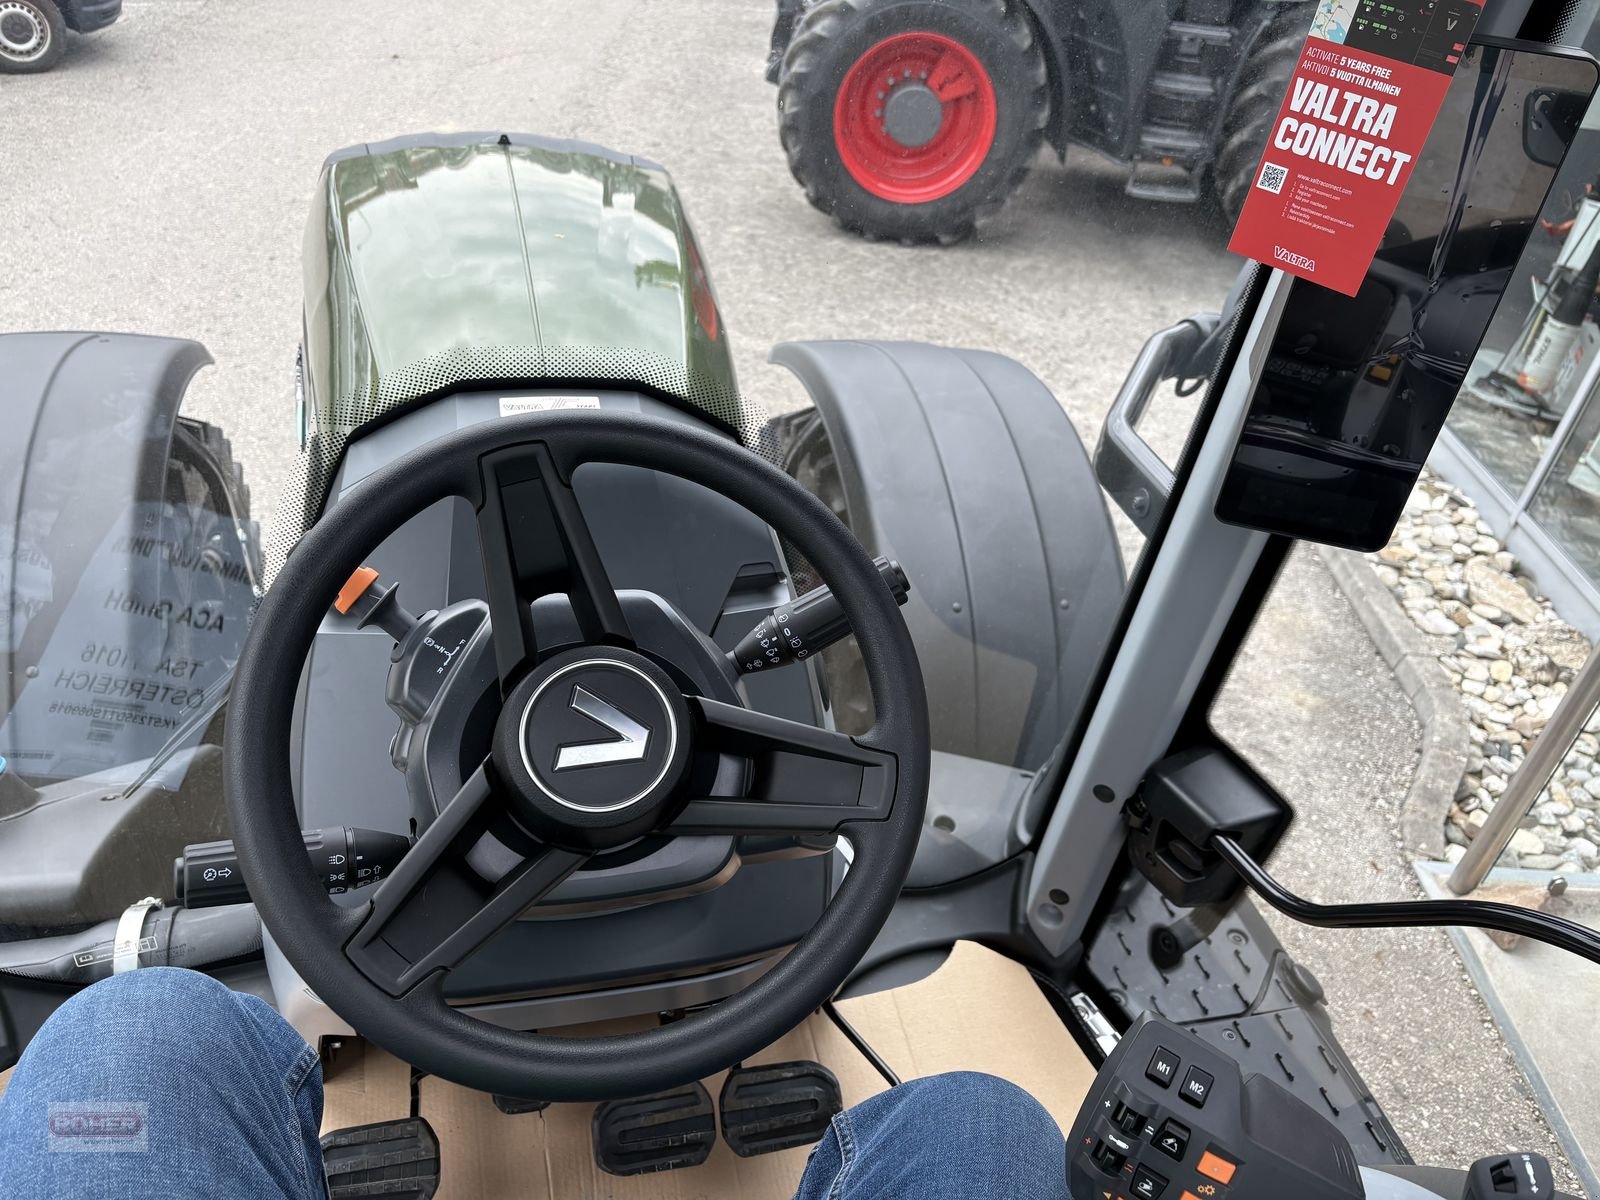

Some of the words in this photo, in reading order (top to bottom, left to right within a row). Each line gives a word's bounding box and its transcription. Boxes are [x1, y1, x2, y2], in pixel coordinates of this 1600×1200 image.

[1306, 47, 1340, 64] ACTIVATE
[1340, 56, 1347, 66] 5
[1347, 58, 1371, 74] YEARS
[1370, 66, 1392, 79] FREE
[1330, 68, 1336, 76] 5
[1336, 70, 1364, 86] VUOTTA
[1364, 78, 1401, 96] ILMAINEN
[1290, 77, 1398, 140] VALTRA
[1274, 116, 1412, 186] CONNECT
[1297, 174, 1352, 195] www.valtraconnect.com
[1297, 188, 1312, 198] Register
[1309, 188, 1340, 200] valtraconnect.com
[1275, 246, 1315, 272] VALTRA
[1156, 1061, 1170, 1075] M1
[1190, 1080, 1204, 1095] M2
